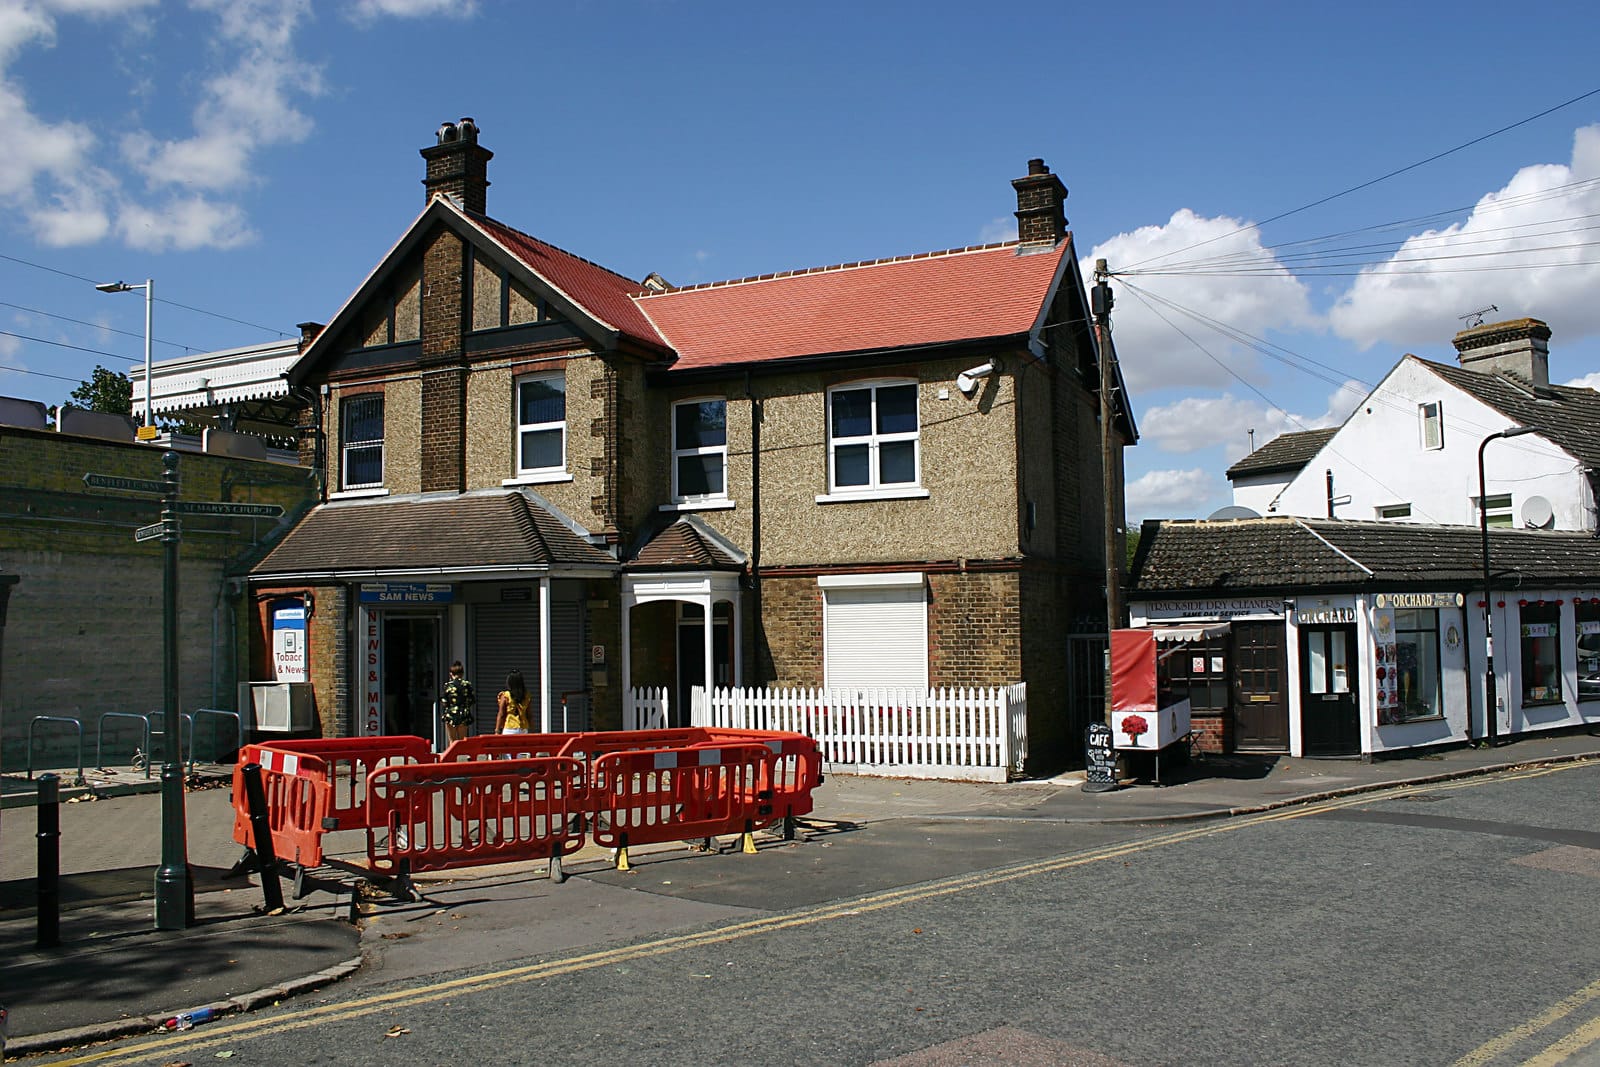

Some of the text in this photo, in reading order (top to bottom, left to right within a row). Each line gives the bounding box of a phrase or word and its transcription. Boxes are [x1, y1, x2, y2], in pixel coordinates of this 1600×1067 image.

[197, 504, 230, 514] MARY'S
[233, 505, 273, 515] CHURCH
[379, 592, 435, 601] SAM NEWS
[1393, 594, 1432, 607] ORCHARD
[1151, 599, 1281, 612] TRACKSIDE DRY CLEANERS
[1299, 607, 1355, 622] ORCHARD
[276, 652, 303, 662] Tobacc
[278, 665, 305, 674] & News
[367, 610, 379, 737] NEWS & MAG
[1090, 734, 1110, 747] CAFE
